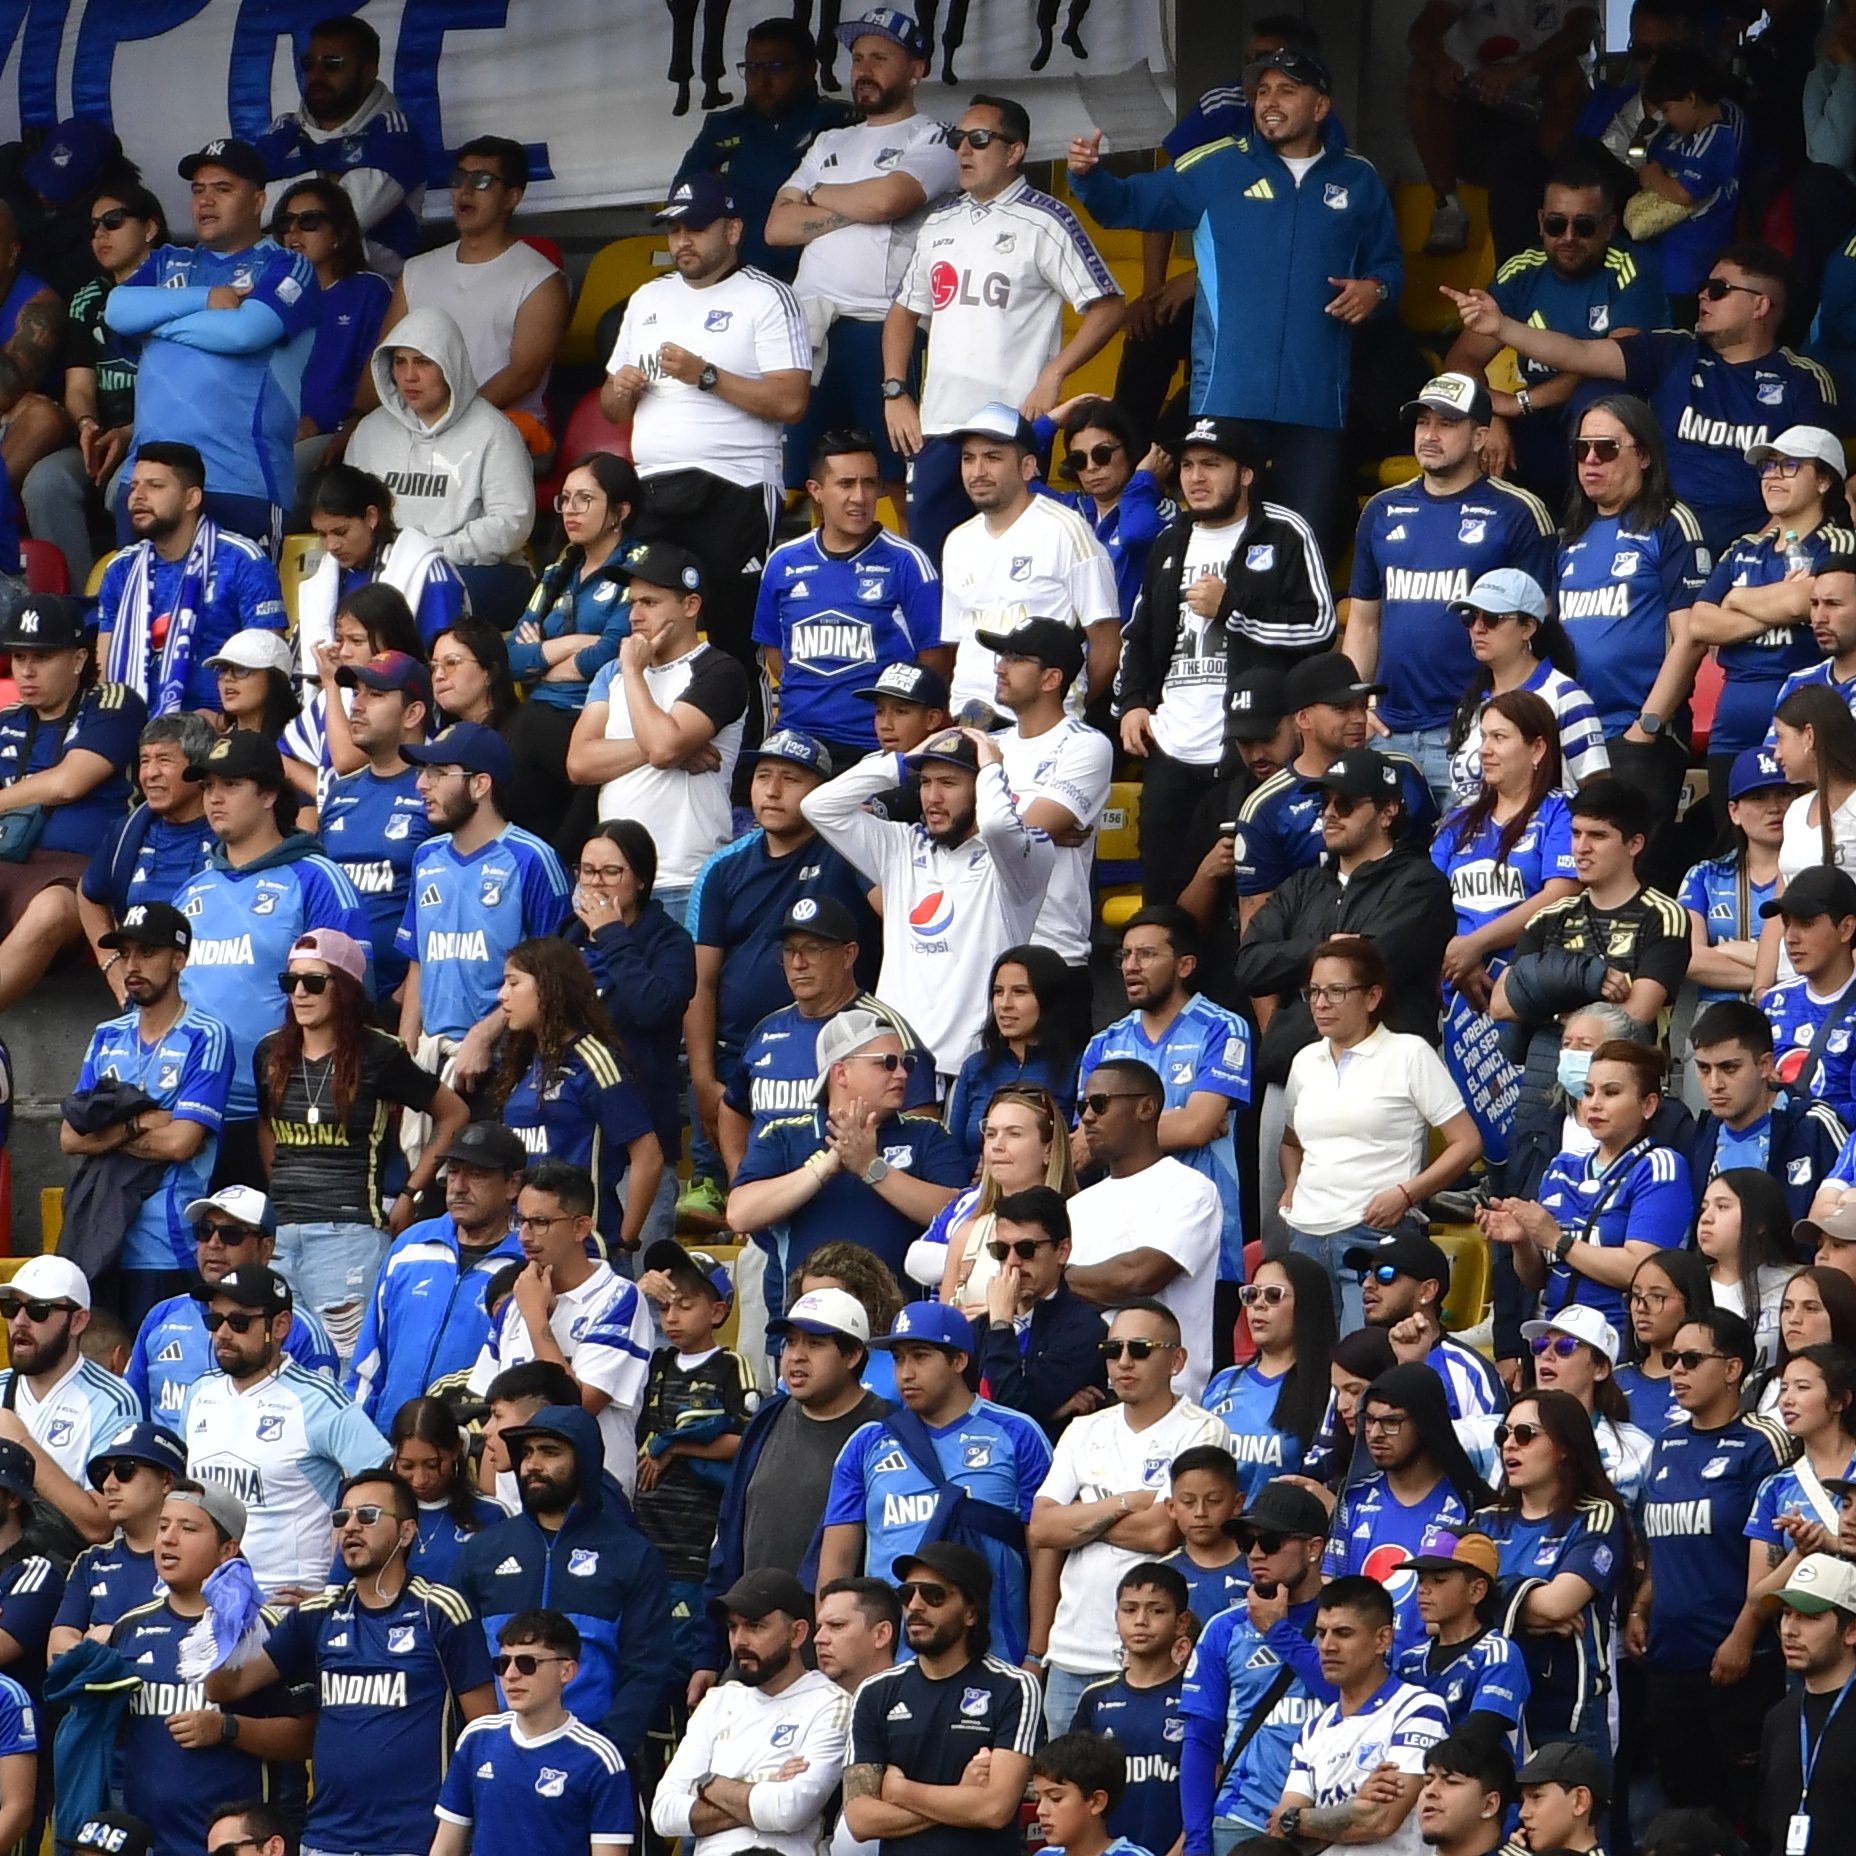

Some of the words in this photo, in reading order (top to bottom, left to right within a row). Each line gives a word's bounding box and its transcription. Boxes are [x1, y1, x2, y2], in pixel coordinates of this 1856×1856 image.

[955, 272, 1009, 310] LG
[1677, 405, 1770, 453] ANDINA
[388, 472, 447, 499] PUMA
[1385, 567, 1469, 603] ANDINA
[19, 609, 40, 633] NY
[790, 624, 875, 662] ANDINA
[1182, 660, 1201, 675] THE
[1230, 689, 1252, 711] H!
[1758, 752, 1778, 775] LA
[1102, 814, 1122, 825] 156
[1451, 870, 1524, 902] ANDINA
[123, 905, 148, 927] NY
[185, 934, 253, 969] NDINA
[1453, 1040, 1466, 1061] EL
[1463, 1046, 1481, 1074] POR
[750, 1079, 817, 1112] ANDIN
[1466, 1074, 1480, 1095] EL
[1472, 1085, 1492, 1114] CON
[270, 1117, 349, 1148] ANDINA
[894, 1310, 913, 1332] LA
[321, 1671, 407, 1708] ANDINA
[1403, 1731, 1439, 1748] LEON
